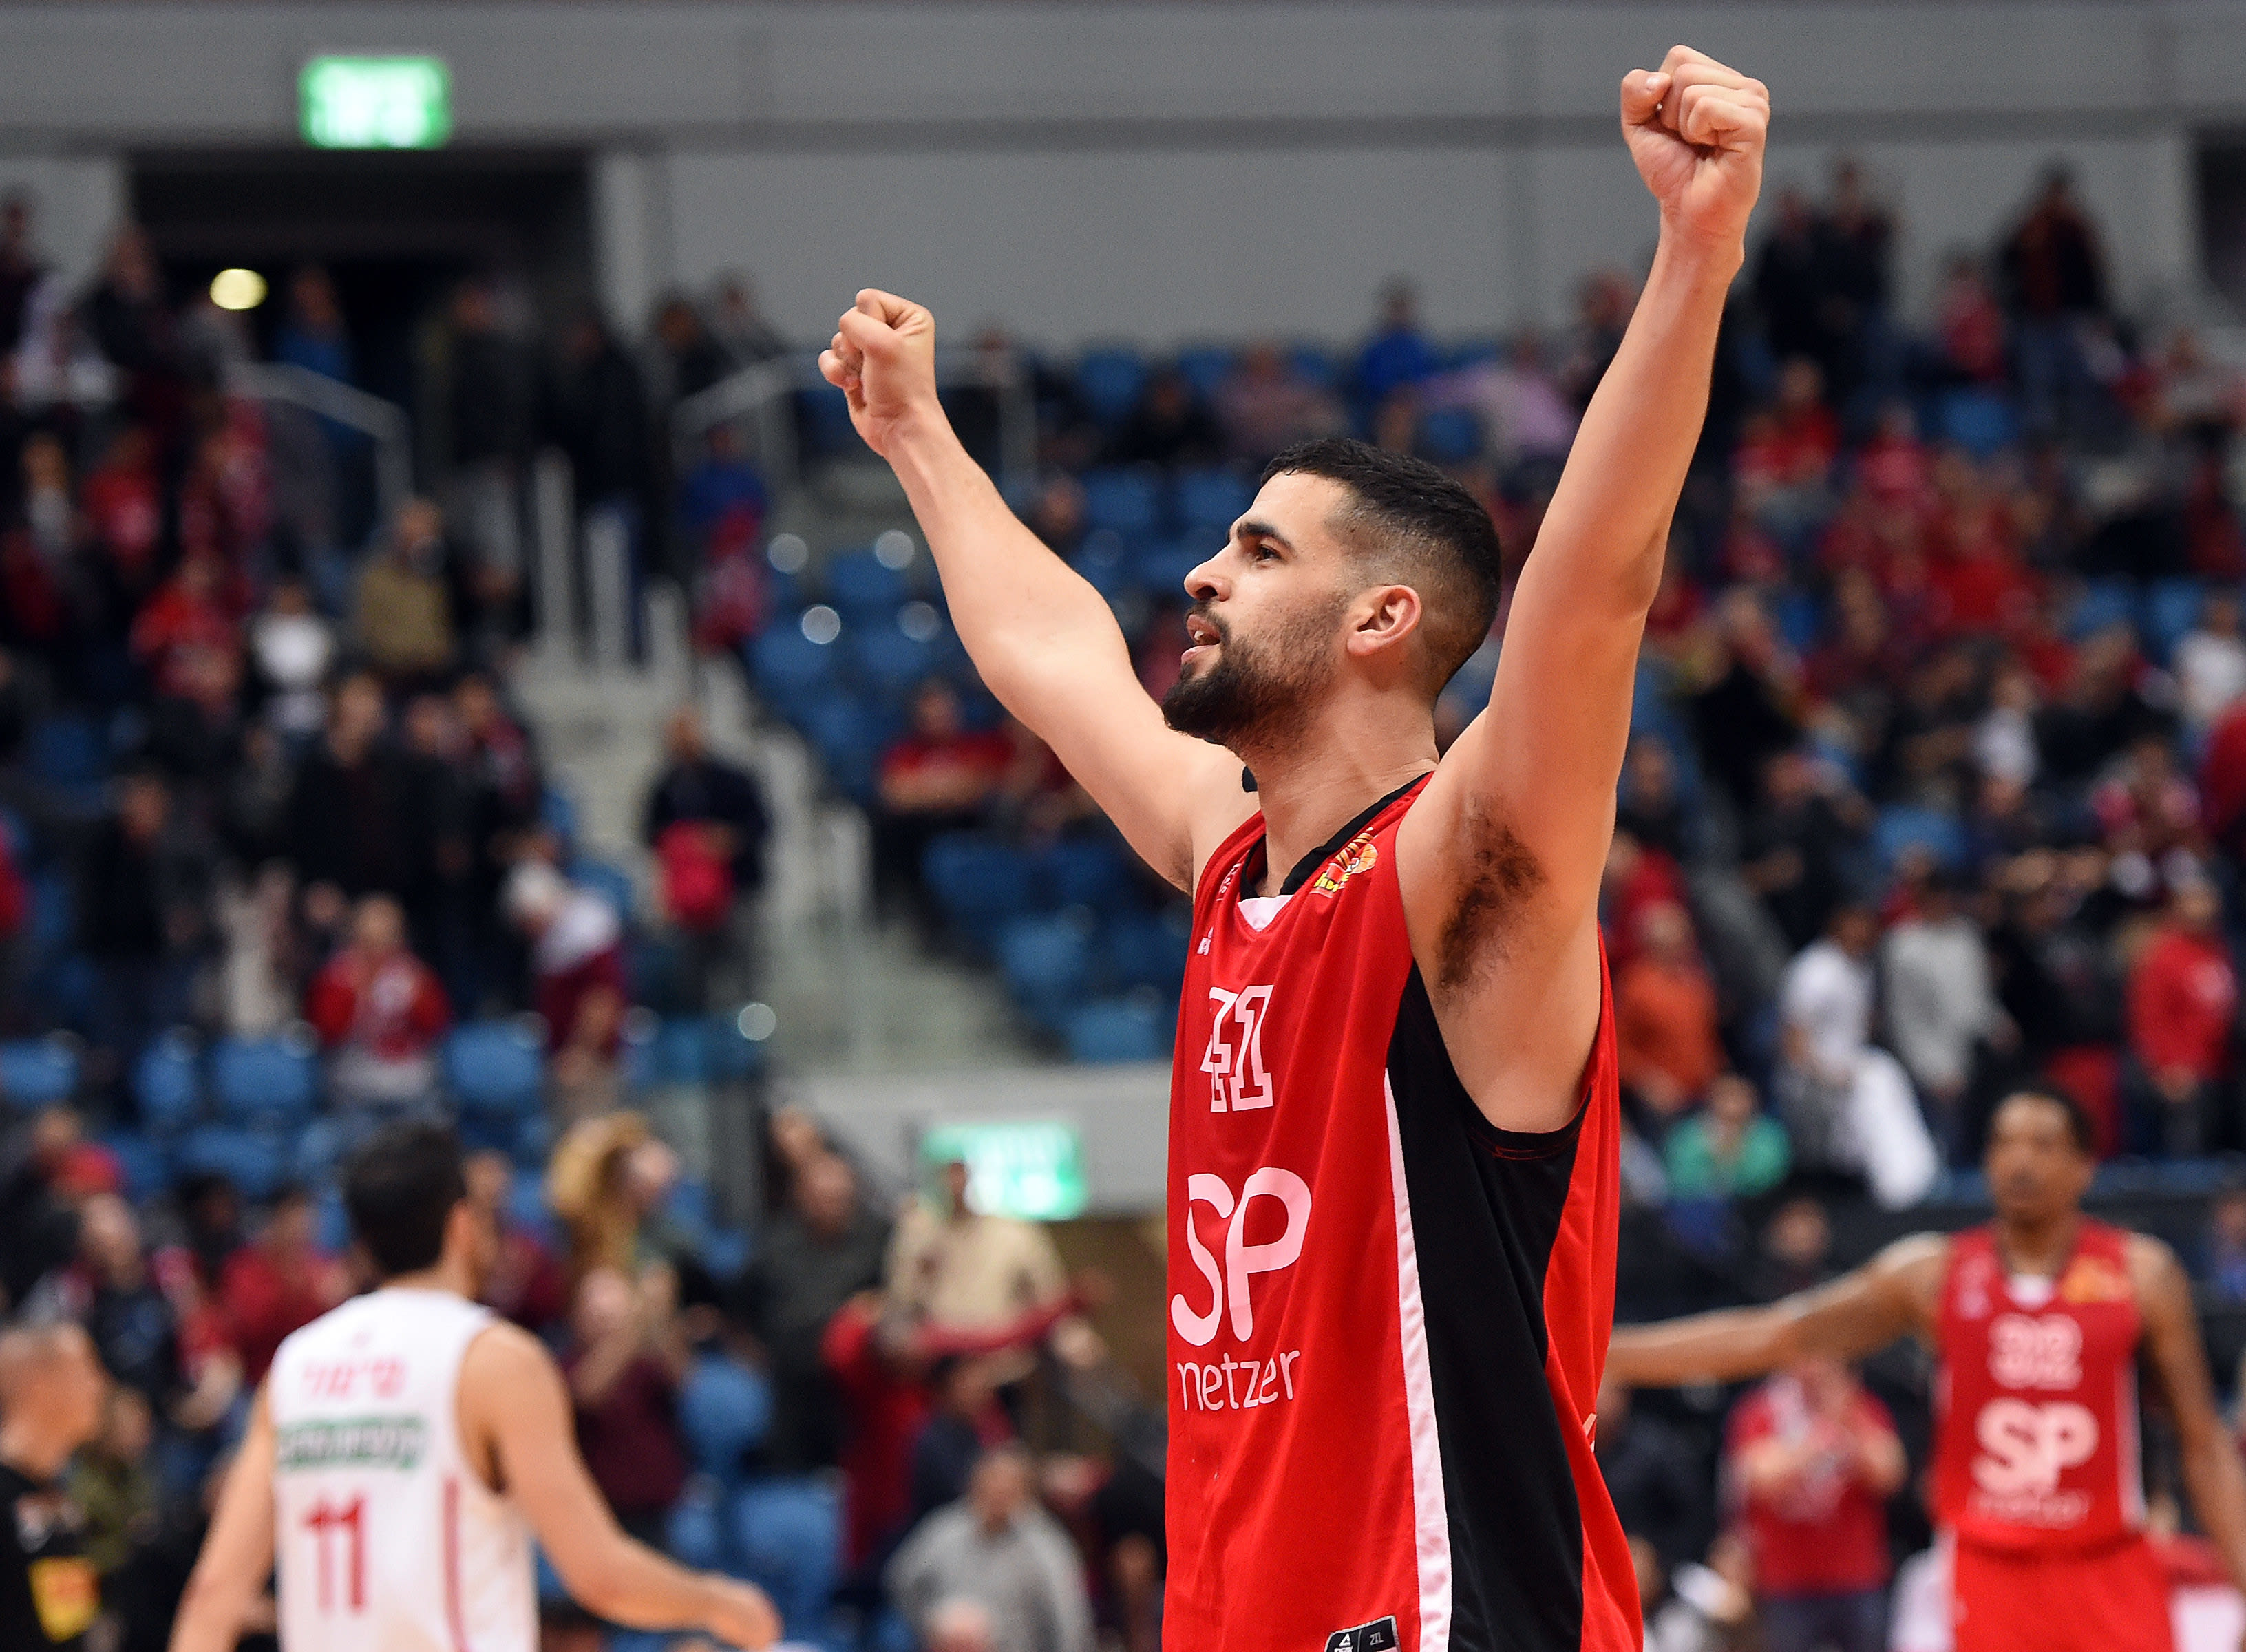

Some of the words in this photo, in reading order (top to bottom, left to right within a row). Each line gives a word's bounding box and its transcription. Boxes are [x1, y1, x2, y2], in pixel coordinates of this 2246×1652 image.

[1171, 1167, 1312, 1346] SP
[1176, 1350, 1300, 1410] netzer
[1969, 1399, 2099, 1496] SP
[301, 1491, 370, 1615] 11
